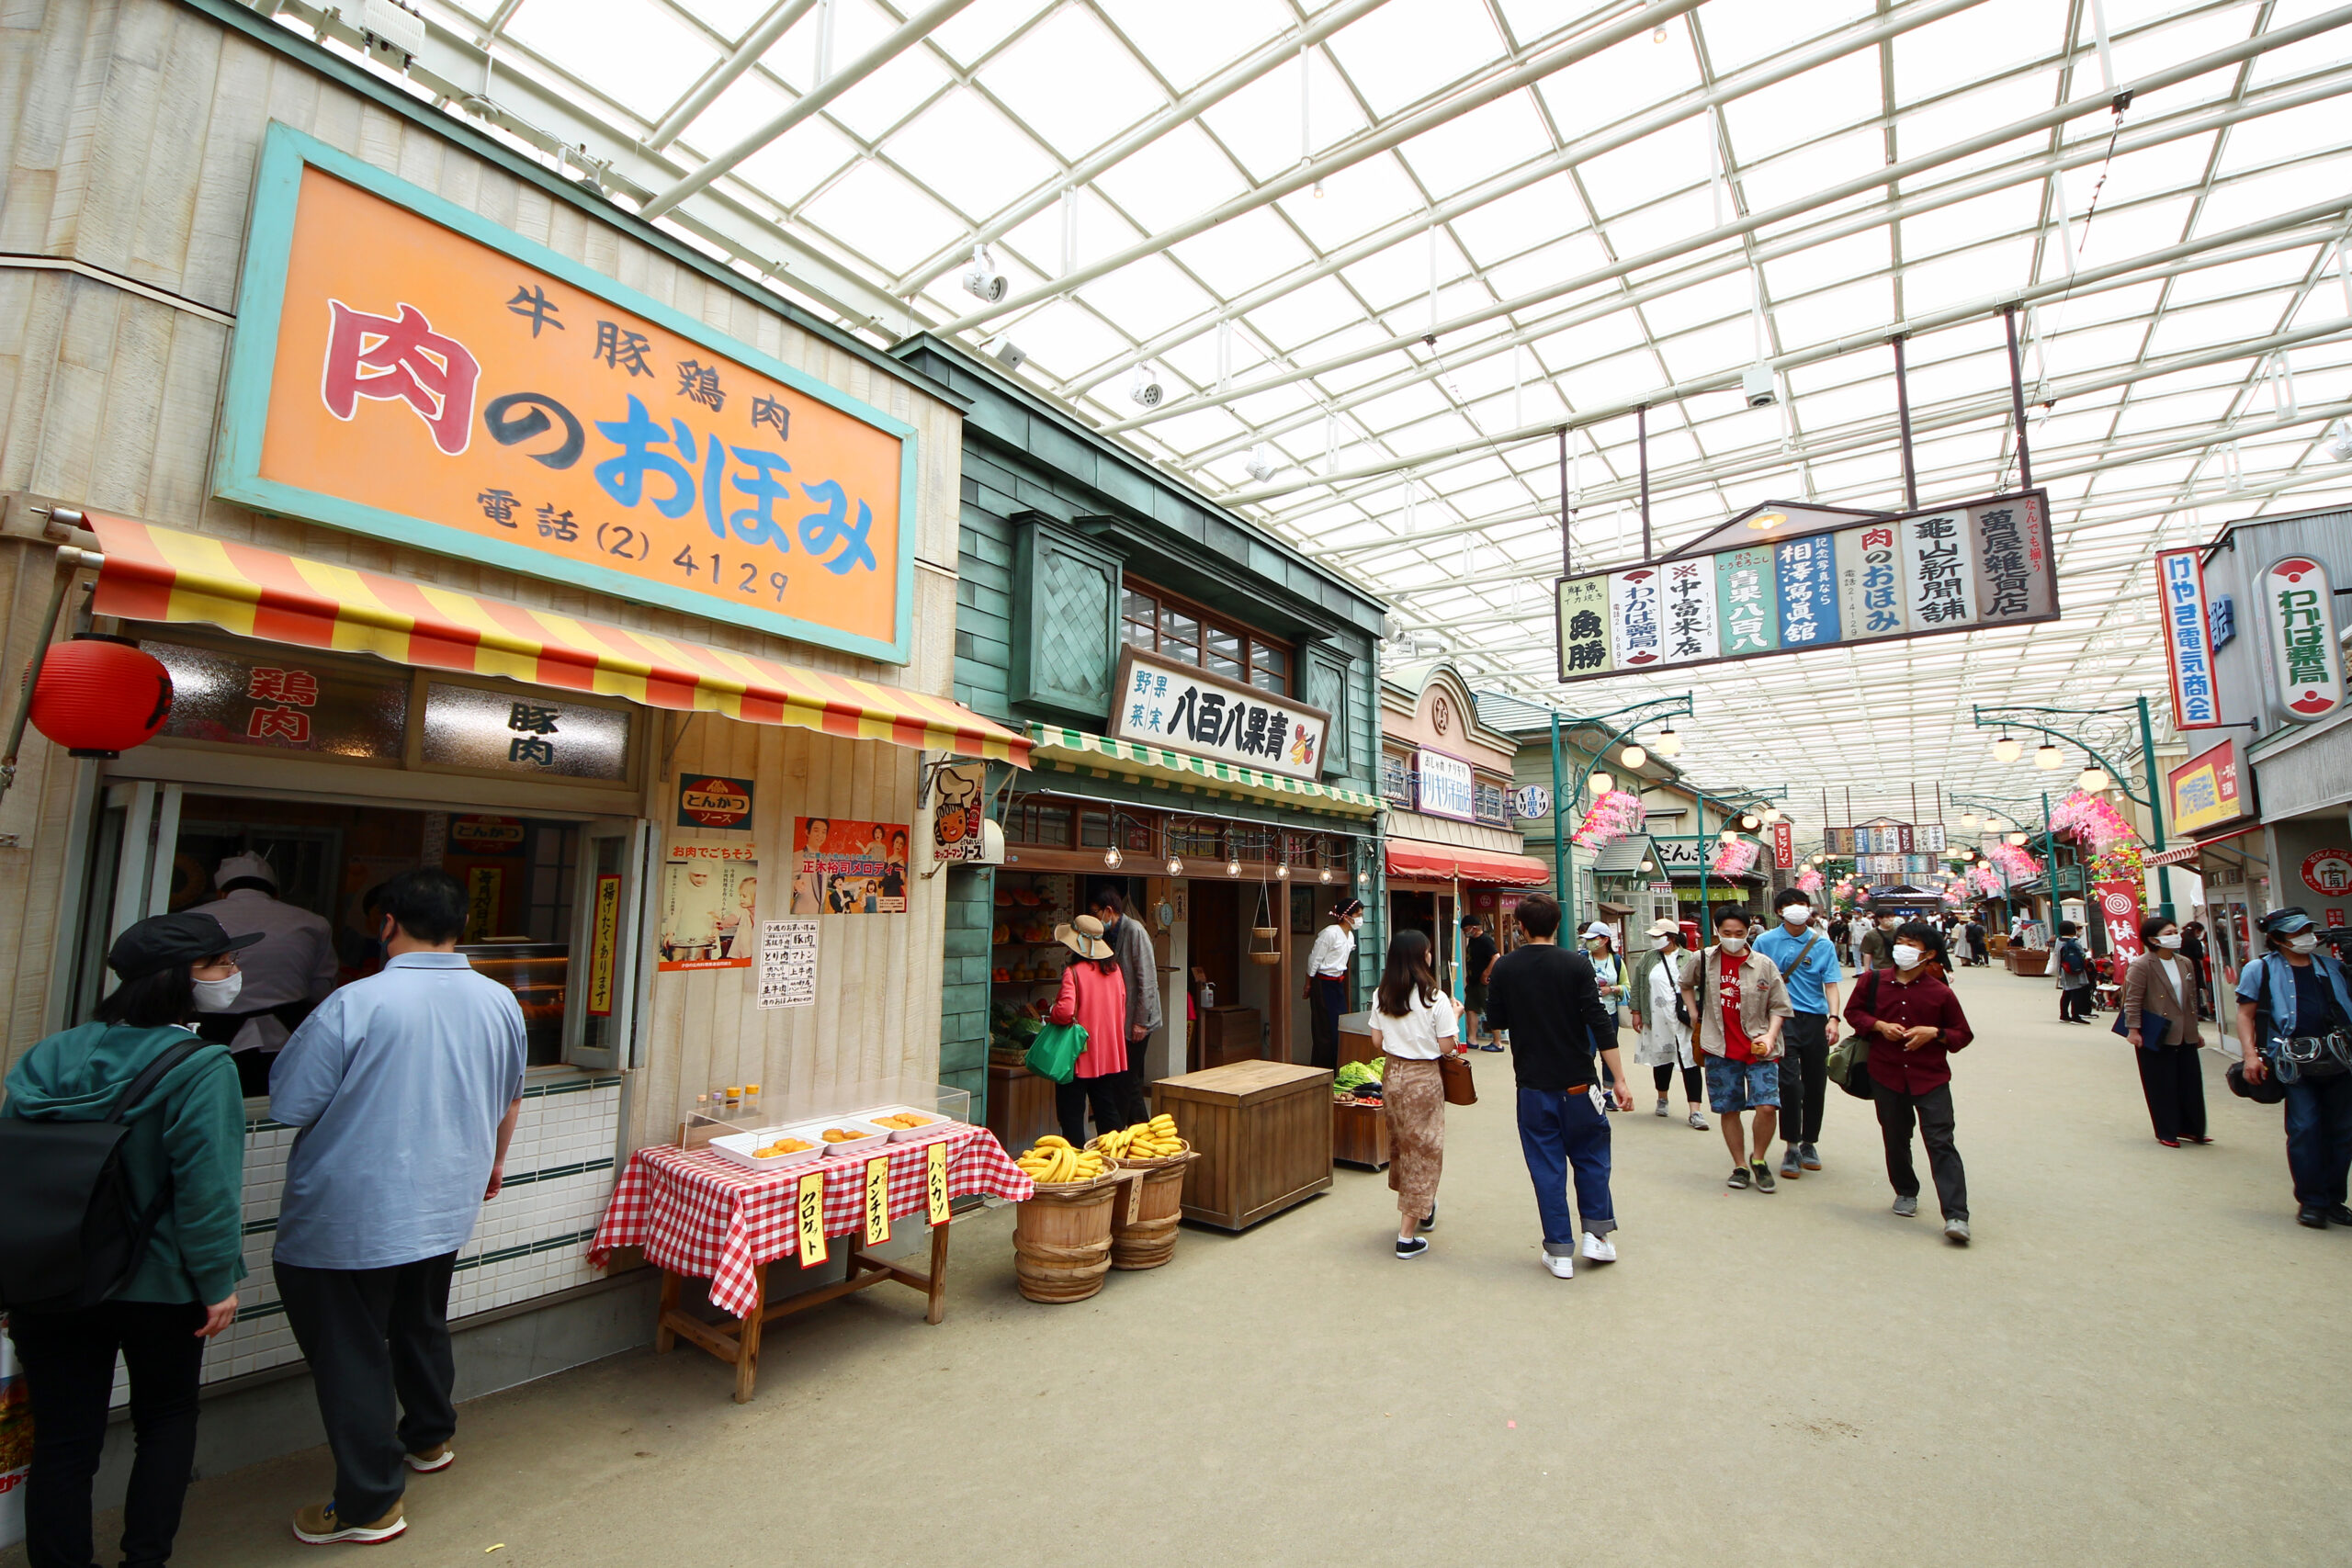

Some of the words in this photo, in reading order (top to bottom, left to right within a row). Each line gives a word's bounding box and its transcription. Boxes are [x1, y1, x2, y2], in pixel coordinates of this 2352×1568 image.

[505, 285, 791, 442] 牛豚鶏肉
[322, 298, 877, 576] 肉のおほみ
[1718, 557, 1769, 571] とうもろこし
[2025, 499, 2041, 572] なんでも揃う
[1815, 537, 1831, 606] 記念写真なら
[1860, 528, 1901, 632] 肉のおほみ
[1568, 609, 1607, 671] 魚勝
[1727, 569, 1768, 651] 青果八百八
[2168, 557, 2211, 720] けやき電気商会
[246, 666, 318, 742] 鶏肉
[1128, 670, 1151, 728] 野菜
[1148, 675, 1168, 733] 果実
[507, 702, 559, 767] 豚肉
[458, 825, 519, 839] とんかつ
[687, 795, 745, 810] とんかつ
[701, 812, 731, 823] ソース
[673, 846, 752, 860] お肉でごちそう
[802, 861, 905, 875] 正木裕司メロディー
[934, 848, 962, 859] キッコーマン
[961, 845, 982, 860] ソース
[595, 882, 615, 1006] 揚げたてあります
[764, 952, 789, 961] とり肉
[791, 951, 814, 959] マトン
[794, 934, 813, 944] 豚肉
[868, 1175, 882, 1241] メンチカツ
[928, 1162, 944, 1217] ハムカツ
[801, 1191, 818, 1256] クロケット
